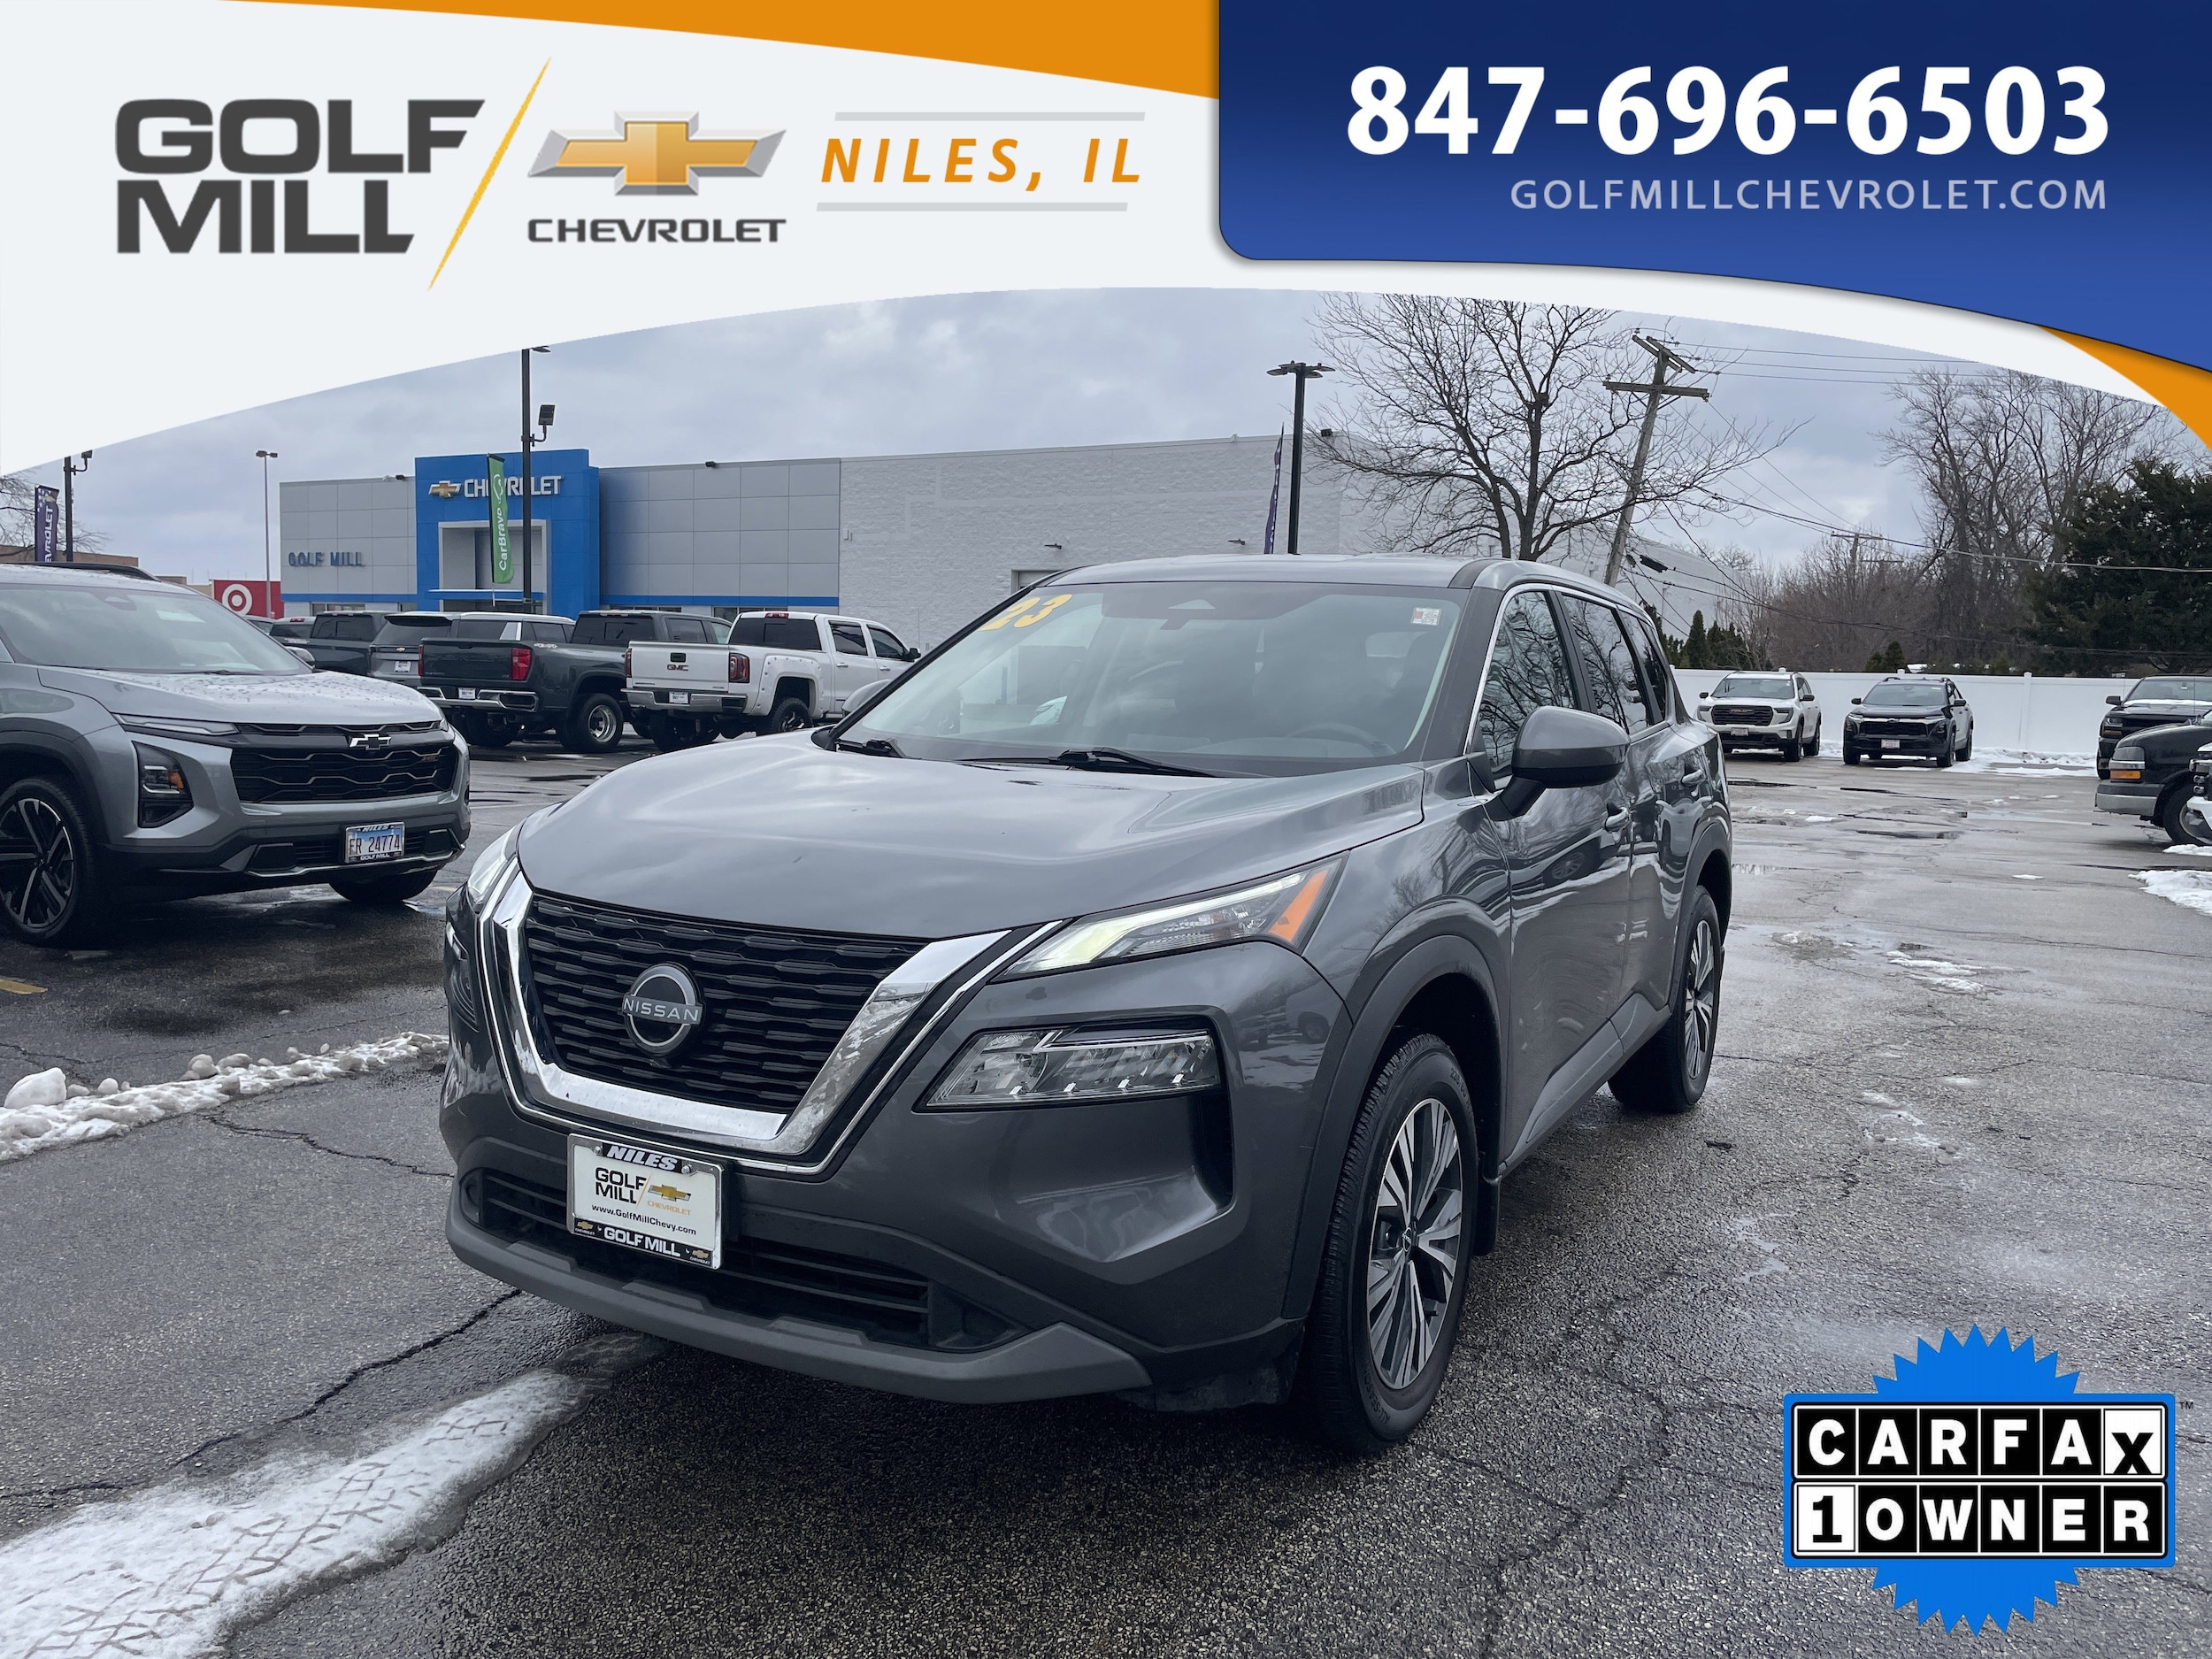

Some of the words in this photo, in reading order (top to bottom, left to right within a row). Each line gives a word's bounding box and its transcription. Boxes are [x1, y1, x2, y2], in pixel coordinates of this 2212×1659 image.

[464, 475, 563, 498] CHRLET
[496, 507, 508, 571] CarBravo
[288, 551, 324, 567] GOLF
[330, 551, 364, 567] MILL
[977, 594, 1072, 631] 23
[368, 833, 400, 854] 24774
[623, 997, 699, 1022] NISSAN
[606, 1145, 678, 1171] NILES
[595, 1167, 647, 1190] GOLF
[595, 1182, 637, 1204] MILL
[591, 1204, 696, 1235] www.GolfMillChevy.com
[647, 1200, 692, 1216] CHEVROLET
[603, 1226, 644, 1247] GOLF
[644, 1238, 681, 1257] MILL
